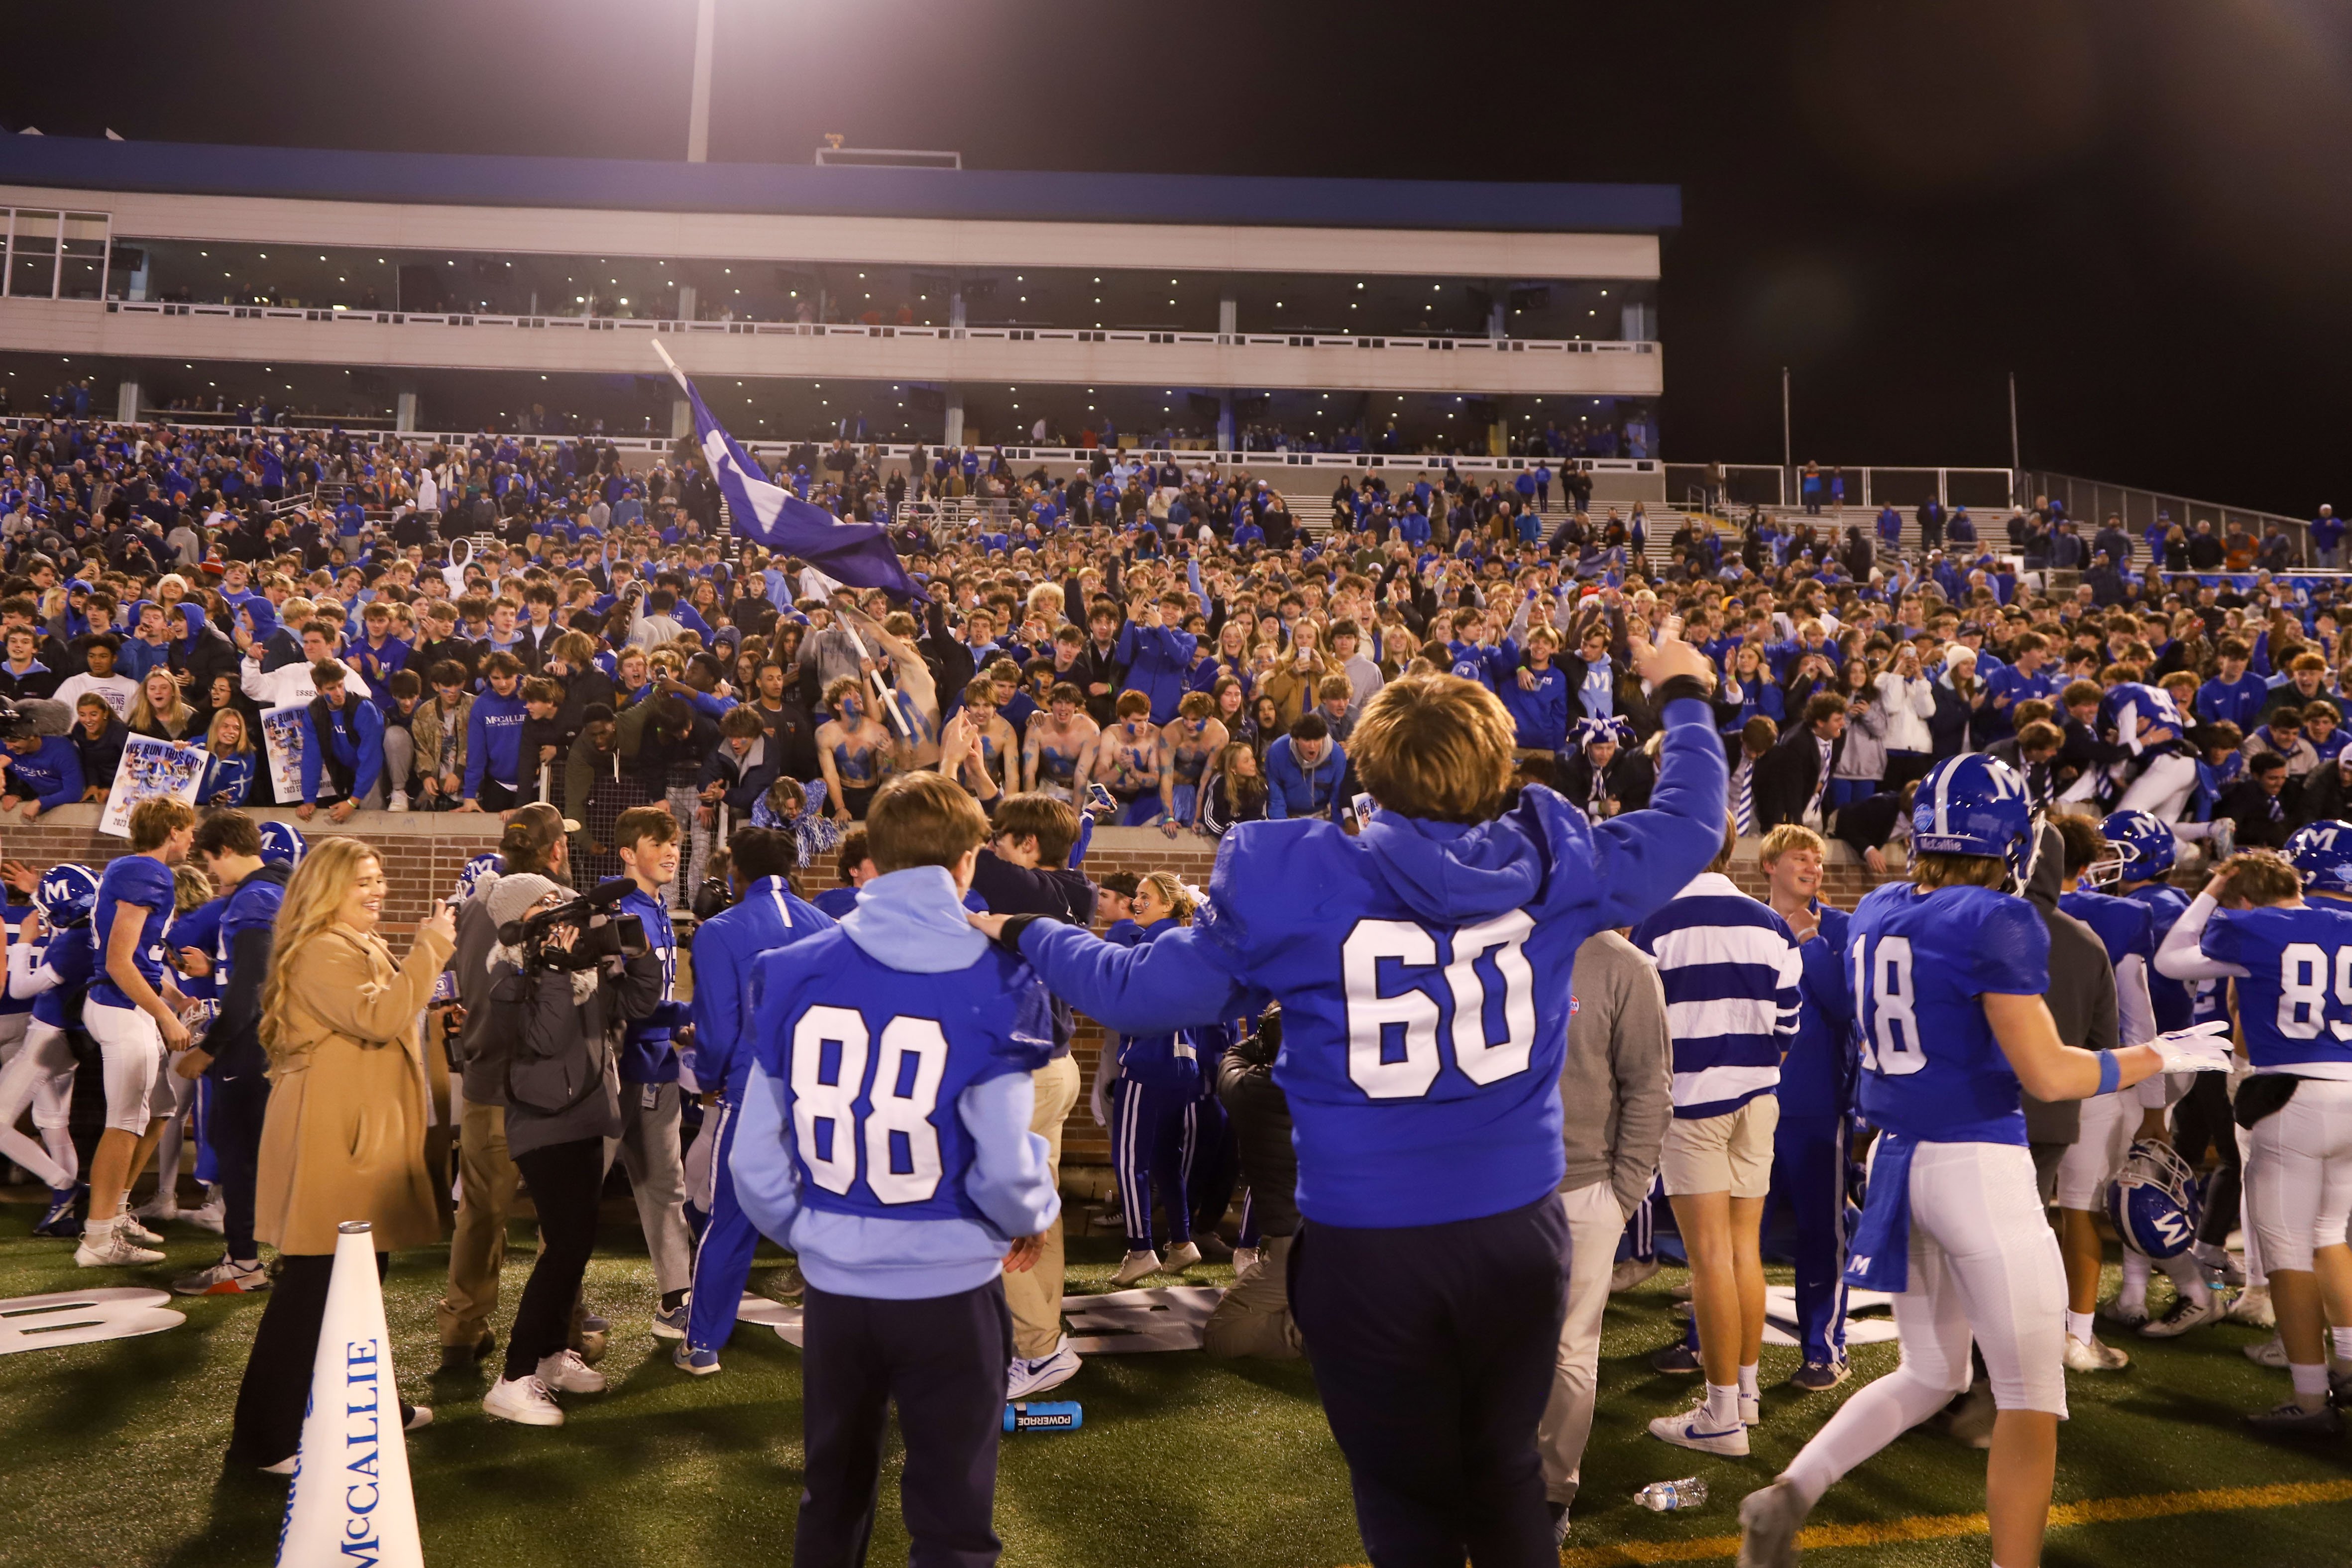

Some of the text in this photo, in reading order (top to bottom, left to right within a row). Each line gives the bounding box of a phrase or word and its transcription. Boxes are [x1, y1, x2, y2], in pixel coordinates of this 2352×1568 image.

[1457, 666, 1470, 675] M
[1583, 671, 1610, 692] M
[263, 716, 276, 729] WE
[278, 712, 294, 723] RUN
[125, 743, 204, 771] WE RUN THIS CITY
[1980, 763, 2032, 806] M
[2128, 812, 2168, 840] M
[1920, 837, 1962, 851] McCallie
[2296, 827, 2339, 852] M
[470, 858, 494, 883] M
[44, 879, 72, 904] M
[436, 980, 446, 991] 3
[1341, 907, 1538, 1101] 60
[1851, 933, 1928, 1076] 18
[789, 1004, 949, 1206] 88
[2151, 1210, 2191, 1248] M
[1847, 1254, 1872, 1276] M
[1017, 1416, 1071, 1426] POWERADE
